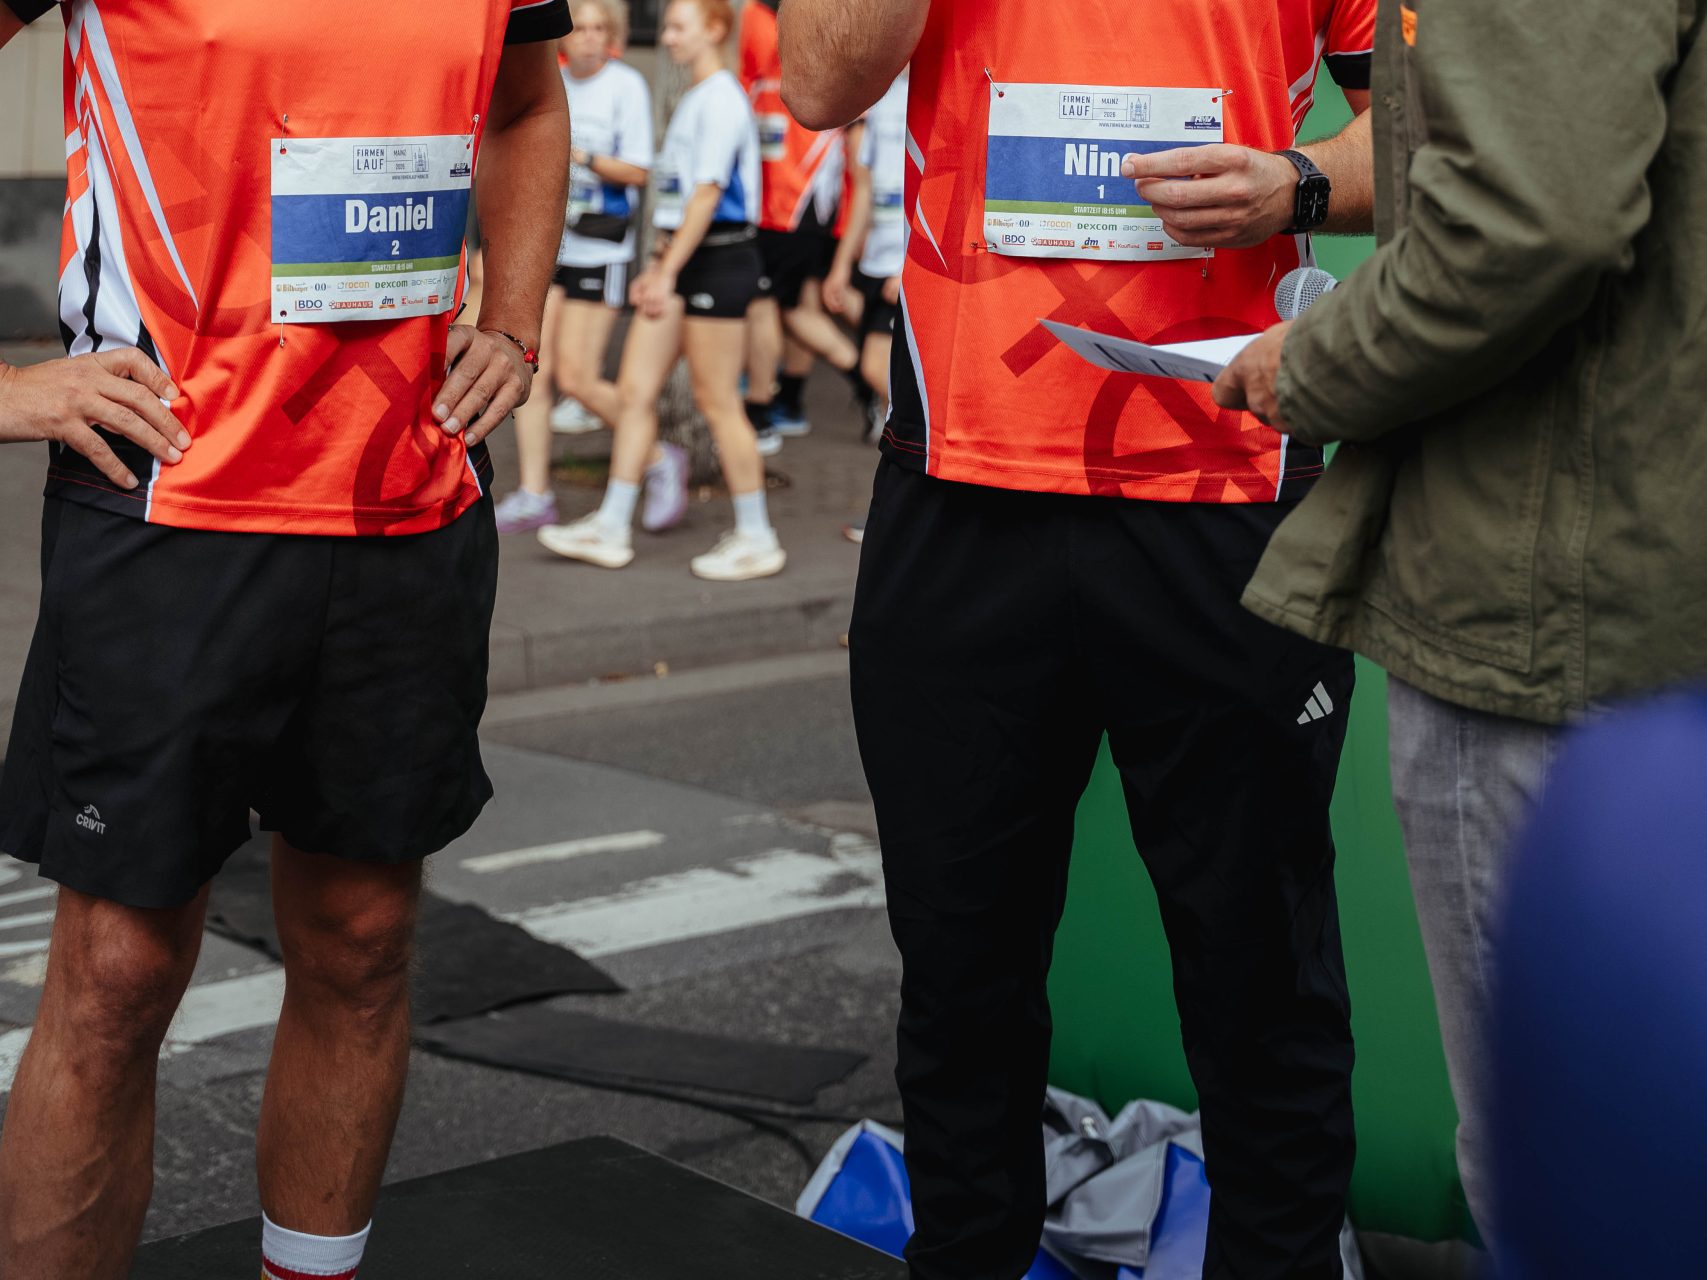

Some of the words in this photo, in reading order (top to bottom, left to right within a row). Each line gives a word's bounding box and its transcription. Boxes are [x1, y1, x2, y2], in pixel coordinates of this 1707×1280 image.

[1063, 95, 1091, 104] FIRMEN
[1062, 104, 1090, 116] LAUF
[356, 148, 385, 157] FIRMEN
[356, 158, 385, 171] LAUF
[1064, 143, 1135, 177] Nin
[1097, 184, 1105, 199] 1
[345, 196, 434, 234] Daniel
[1073, 205, 1101, 214] STARTZEIT
[1115, 207, 1127, 215] UHR
[1122, 224, 1162, 232] BIONTEC
[1004, 234, 1026, 244] BDO
[1038, 238, 1075, 247] BAUHAUS
[1084, 236, 1099, 246] dm
[391, 239, 400, 256] 2
[298, 299, 323, 309] BDO
[336, 300, 373, 309] BAUHAUS
[381, 296, 395, 305] dm
[76, 813, 106, 835] CRIVIT
